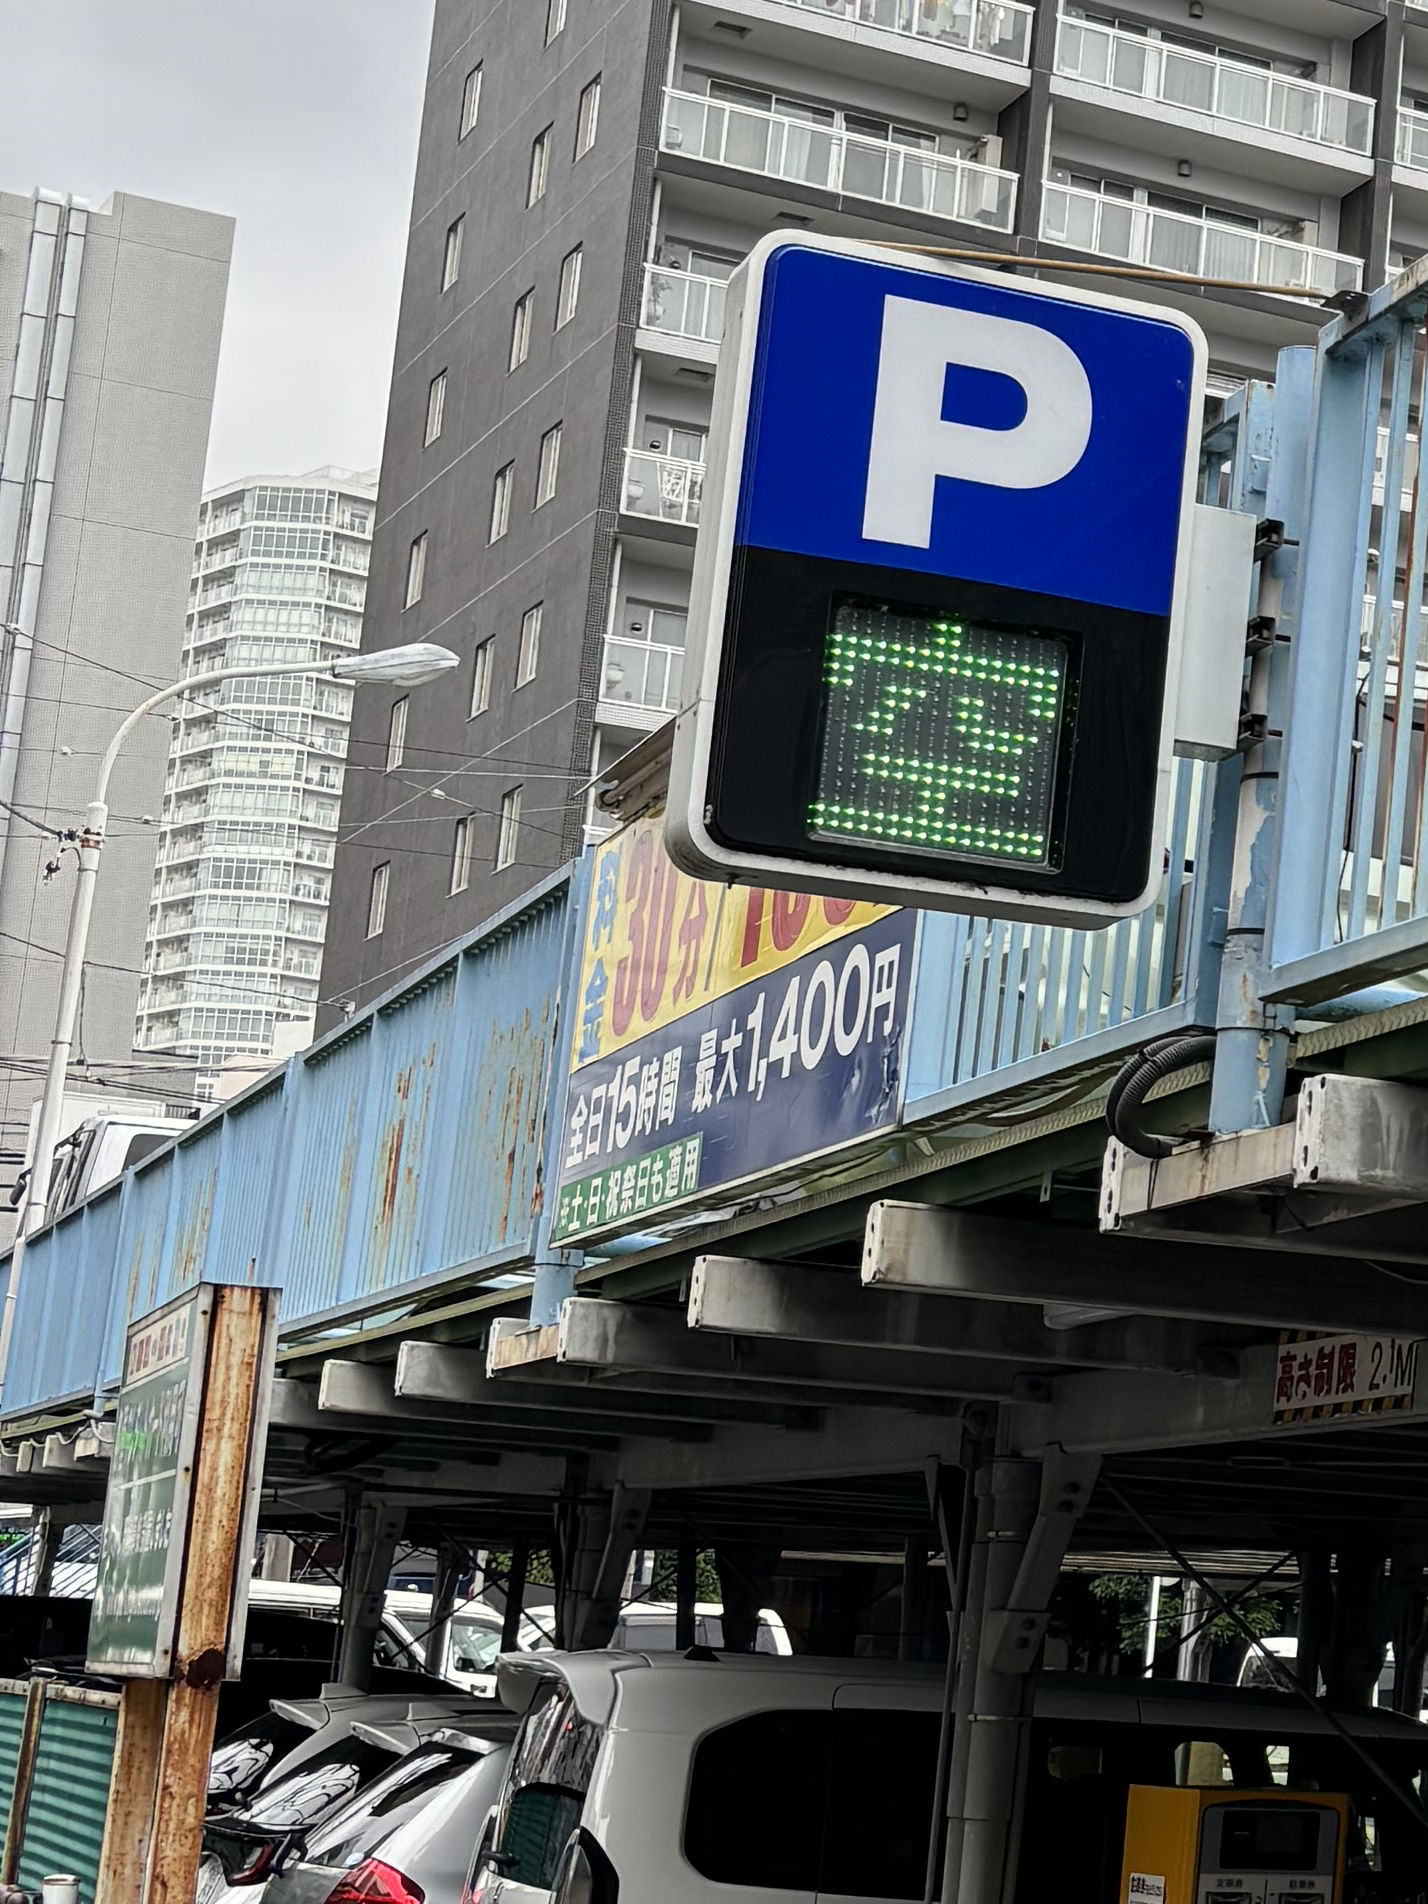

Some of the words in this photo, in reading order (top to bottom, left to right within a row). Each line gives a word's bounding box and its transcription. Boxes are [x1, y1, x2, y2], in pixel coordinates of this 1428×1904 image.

[861, 294, 1093, 550] P
[807, 621, 1062, 859] 空
[565, 1046, 683, 1170] 全日15時間
[691, 943, 901, 1114] 最大1,400円
[1275, 1341, 1358, 1404] 高さ制限
